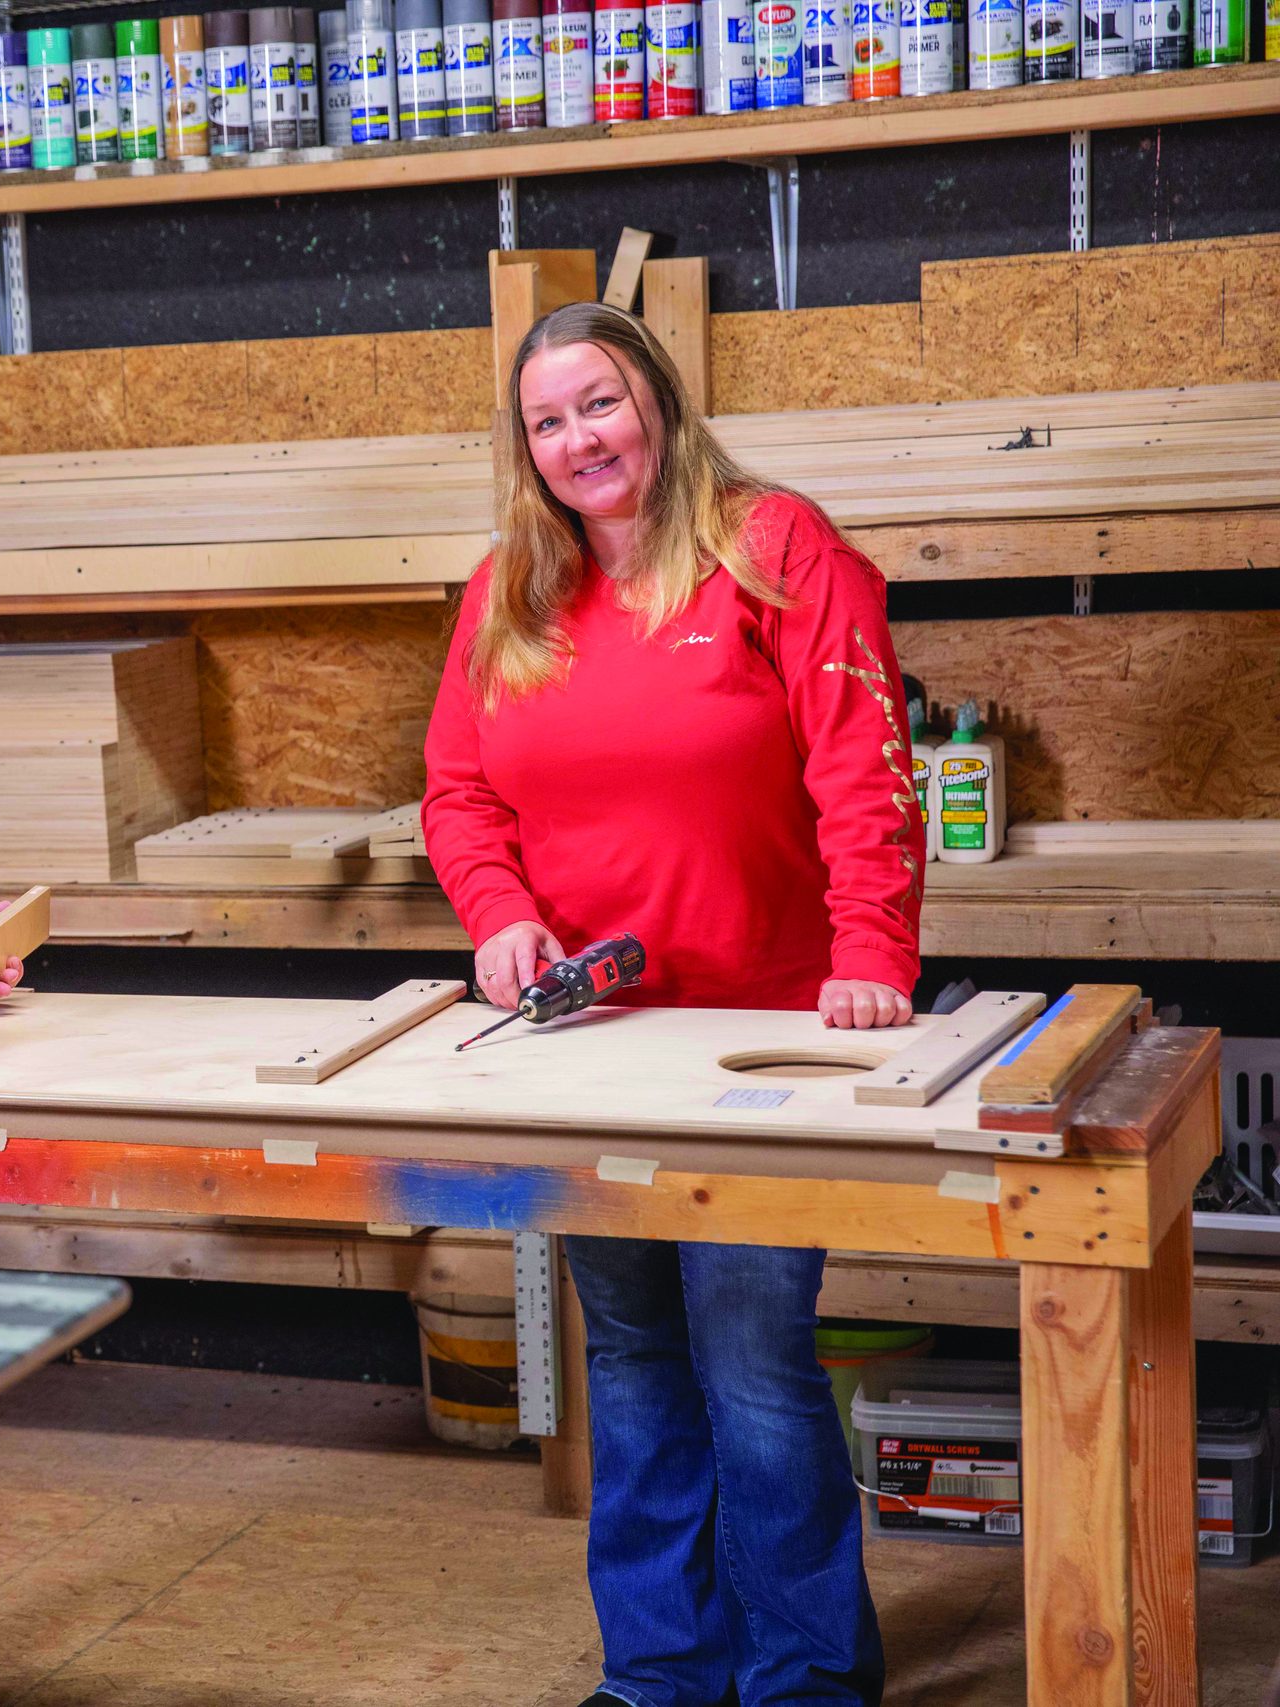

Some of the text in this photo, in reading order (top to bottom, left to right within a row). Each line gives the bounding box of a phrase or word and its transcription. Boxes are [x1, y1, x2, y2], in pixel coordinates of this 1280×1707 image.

[762, 9, 793, 20] KRYLON
[805, 9, 836, 28] 2X
[853, 2, 882, 24] 2X
[1139, 14, 1157, 26] FLAT
[543, 24, 587, 34] USTOLEUM
[502, 37, 532, 58] 2X
[909, 41, 940, 53] PRMER
[500, 71, 537, 80] PRMER
[940, 766, 989, 787] Titebond
[945, 791, 982, 801] ULTIMATE
[907, 1444, 945, 1454] DRYWALL
[947, 1445, 981, 1455] SCREWS
[880, 1461, 891, 1469] #6
